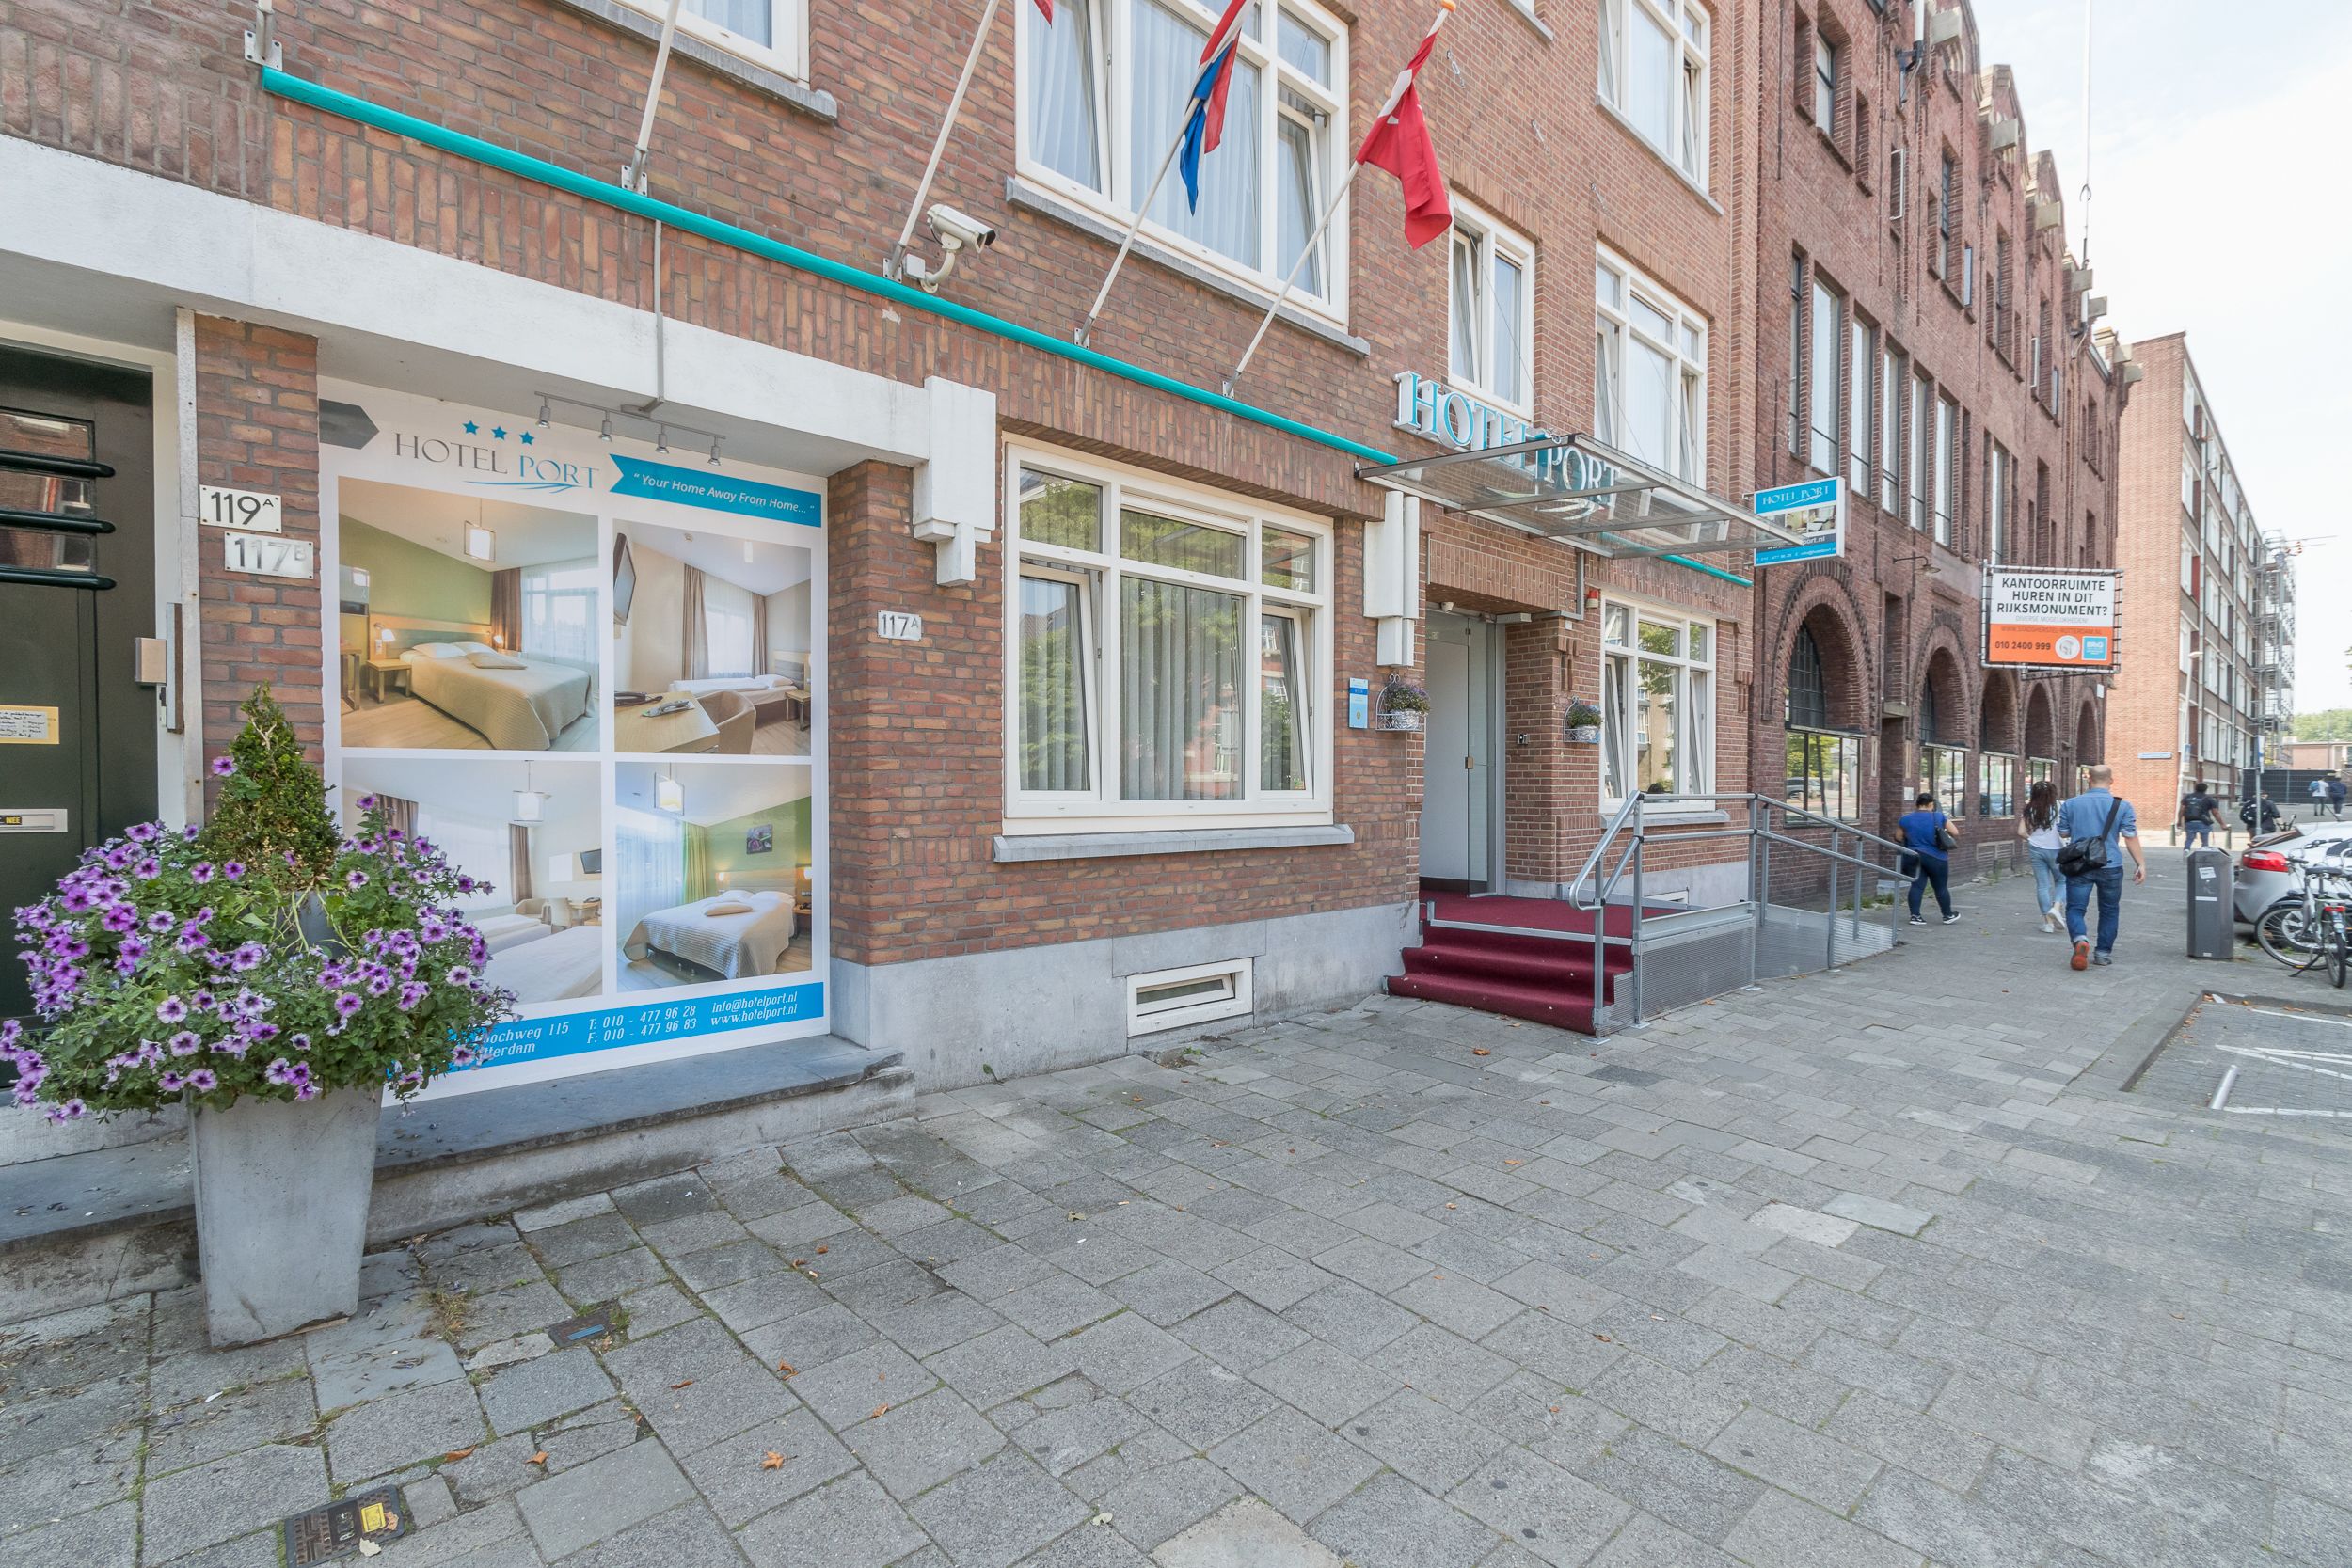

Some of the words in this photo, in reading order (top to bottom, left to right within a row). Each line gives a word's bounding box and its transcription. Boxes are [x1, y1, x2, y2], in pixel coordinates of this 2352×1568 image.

[1392, 370, 1537, 472] HOTEL
[1536, 433, 1622, 511] PORT
[395, 432, 508, 475] HOTEL
[518, 454, 600, 489] PORT
[642, 473, 670, 489] Your
[671, 480, 706, 496] Home
[707, 486, 737, 503] Away
[739, 491, 767, 507] From
[1762, 490, 1798, 505] HOTEL
[1801, 485, 1829, 499] PORT
[2001, 578, 2106, 592] KANTOORRUIMTE
[2011, 591, 2055, 602] HUREN
[2058, 592, 2071, 603] IN
[2074, 593, 2094, 603] DIT
[1996, 602, 2108, 616] RIJKSMONUMENT?
[1994, 641, 2010, 649] 010
[2011, 641, 2033, 650] 2400
[2035, 641, 2051, 651] 999
[712, 991, 798, 1014] info@hotelport.nl
[589, 1018, 596, 1030] T:
[602, 1015, 624, 1029] 010
[640, 1009, 660, 1023] 477
[665, 1007, 678, 1020] 96
[683, 1005, 696, 1017] 28
[710, 1004, 798, 1027] www.hotelport.nl
[474, 1027, 543, 1044] ochweg
[548, 1022, 570, 1036] 115
[587, 1032, 598, 1044] F:
[603, 1027, 625, 1042] 010
[640, 1022, 660, 1037] 477
[665, 1020, 679, 1034] 96
[683, 1018, 697, 1031] 83
[483, 1042, 536, 1058] tterdam
